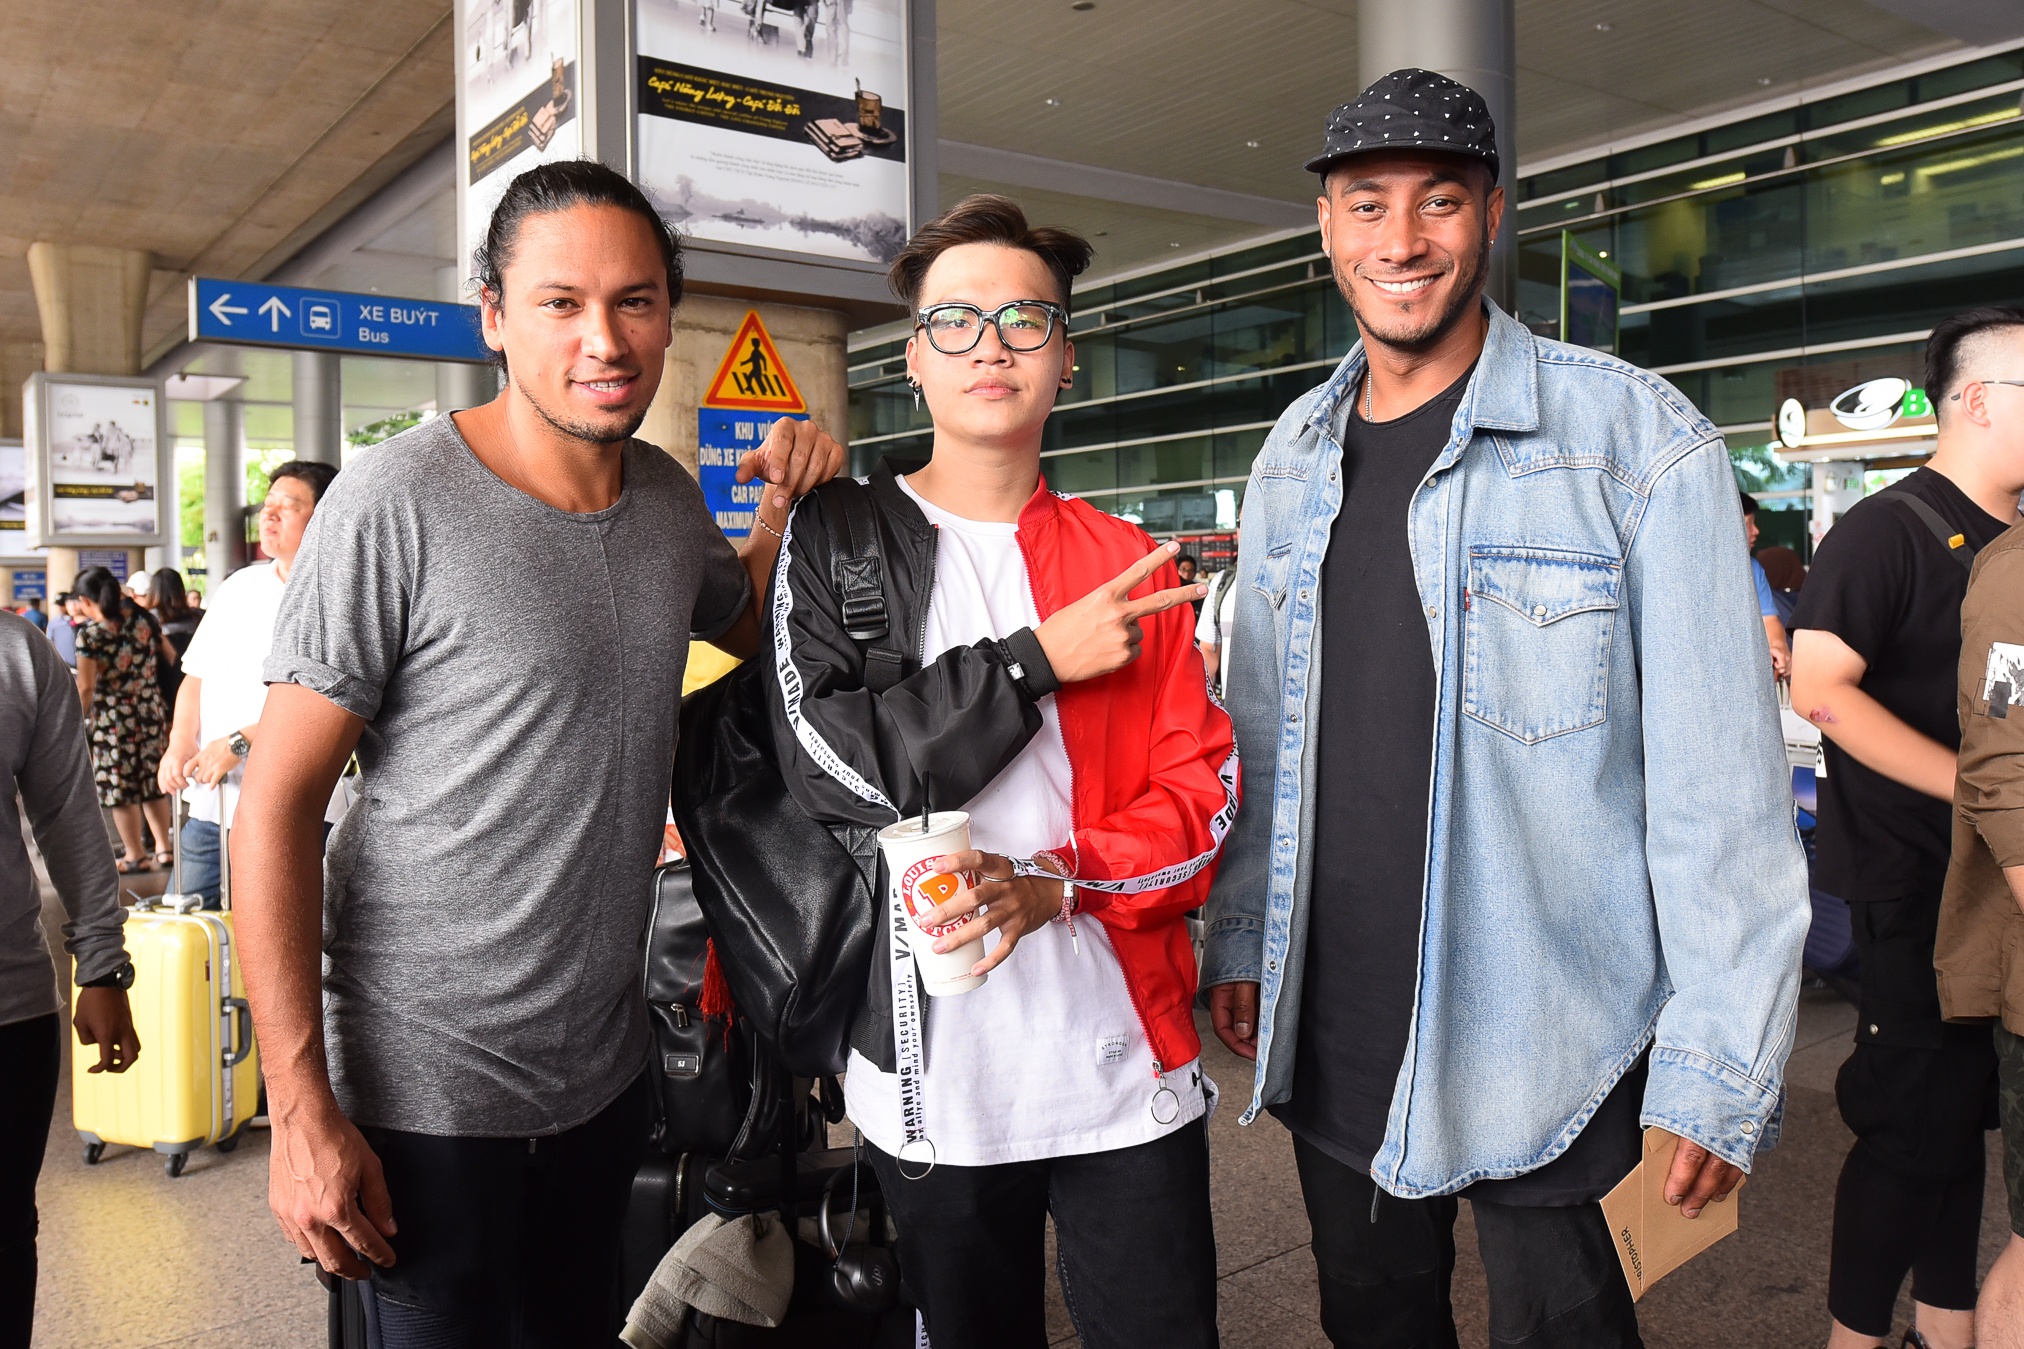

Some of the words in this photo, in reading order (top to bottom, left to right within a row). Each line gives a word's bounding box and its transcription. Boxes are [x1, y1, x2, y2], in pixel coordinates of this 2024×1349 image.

[359, 304, 385, 322] XE
[390, 307, 440, 327] BUÝT
[358, 326, 390, 344] Bus
[735, 421, 754, 441] KHU
[723, 448, 735, 467] XE
[731, 484, 748, 504] CAR
[779, 657, 802, 731] V/MADE
[911, 1027, 919, 1049] your
[911, 1053, 920, 1076] mind
[900, 1065, 918, 1144] WARNING
